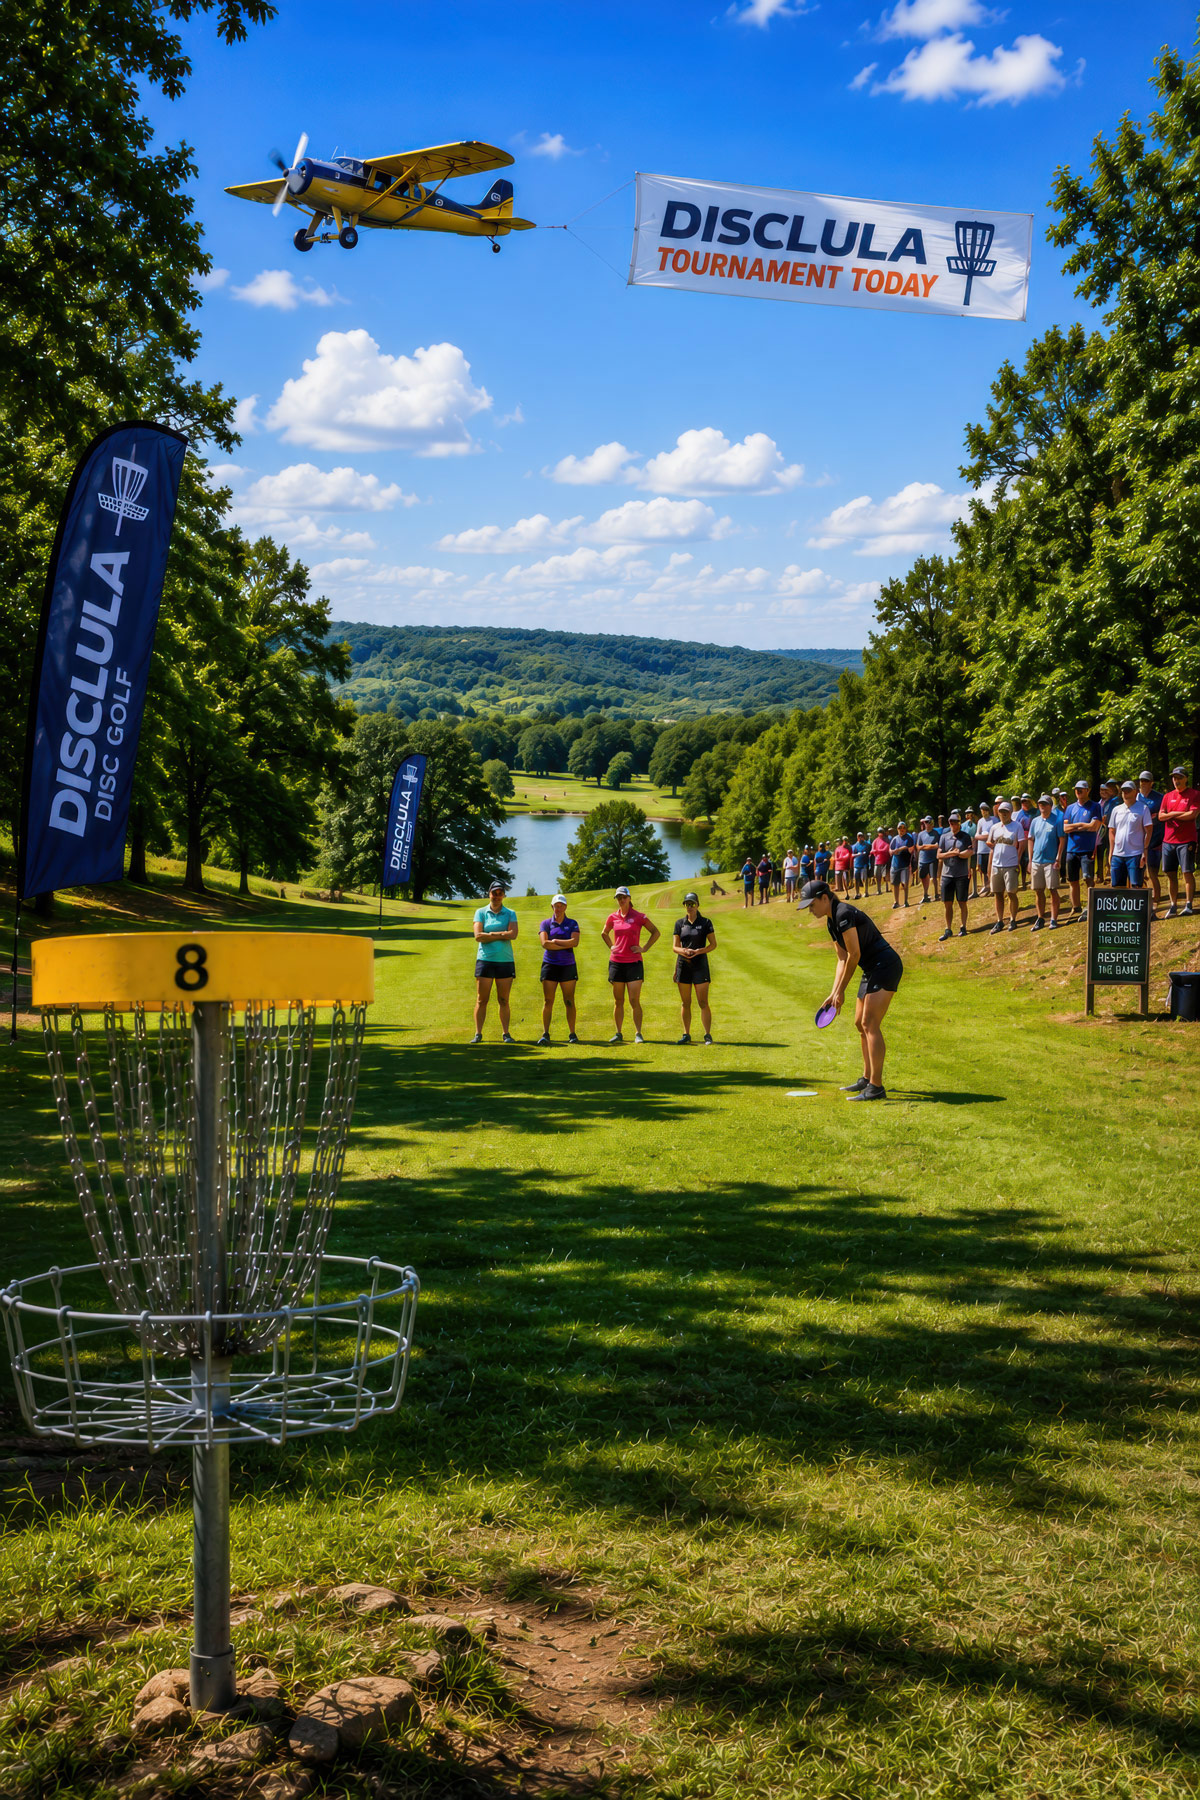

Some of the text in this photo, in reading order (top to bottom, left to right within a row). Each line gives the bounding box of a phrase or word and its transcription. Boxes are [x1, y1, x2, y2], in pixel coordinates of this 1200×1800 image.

[660, 200, 927, 265] DISCLULA
[658, 246, 939, 298] TOURNAMENT TODAY
[49, 552, 130, 837] DISCLULA
[94, 667, 132, 822] DISC GOLF
[1096, 897, 1118, 911] DISC
[1098, 922, 1141, 932] RESPECT
[174, 943, 209, 991] 8
[1097, 952, 1140, 963] RESPECT
